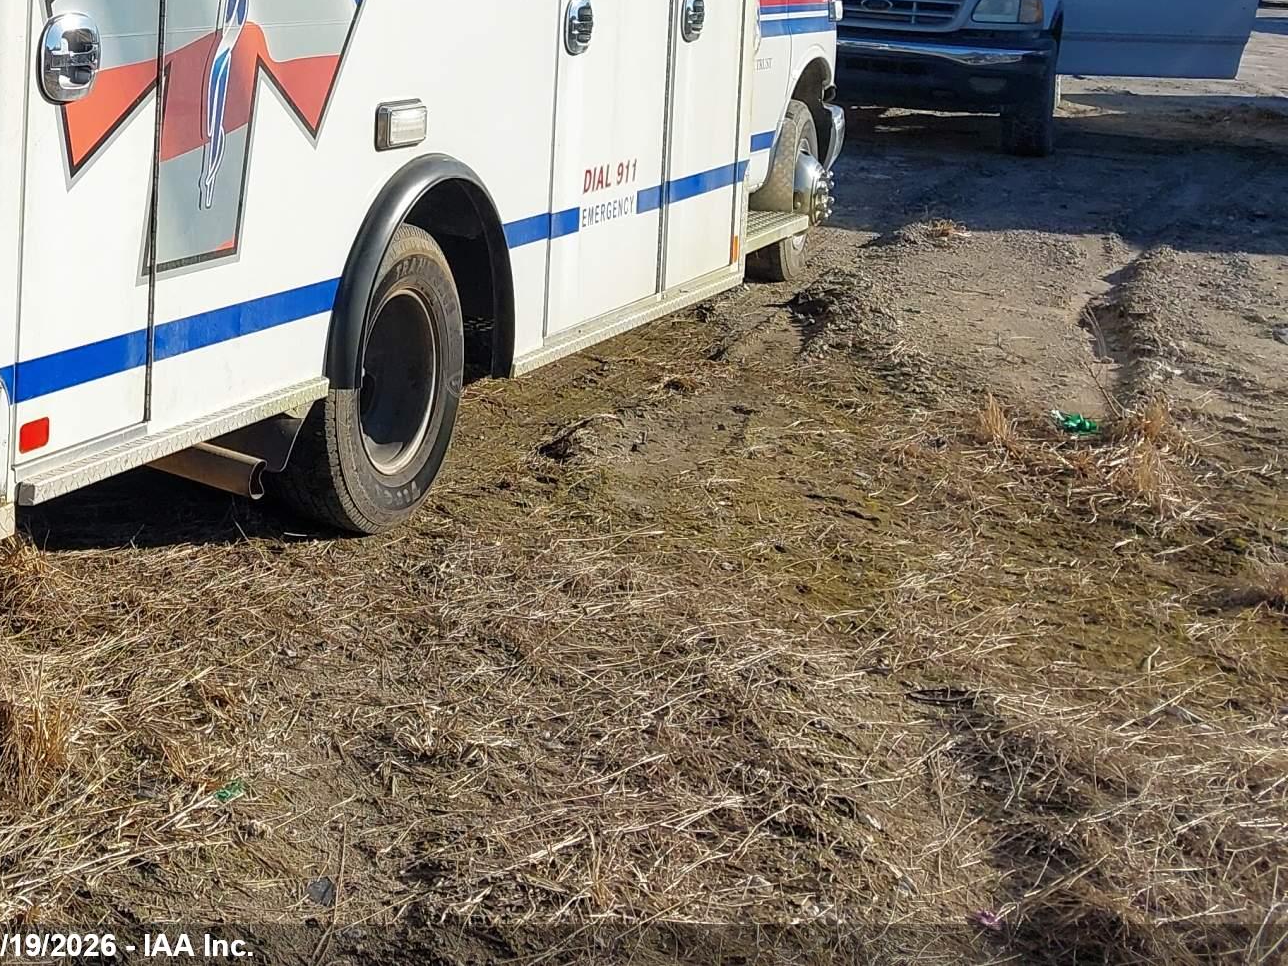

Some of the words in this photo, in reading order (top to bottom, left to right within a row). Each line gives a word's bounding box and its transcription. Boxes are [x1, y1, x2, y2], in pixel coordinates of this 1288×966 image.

[582, 163, 612, 195] DIAL
[616, 157, 638, 186] 911
[581, 194, 635, 227] EMERGENCY
